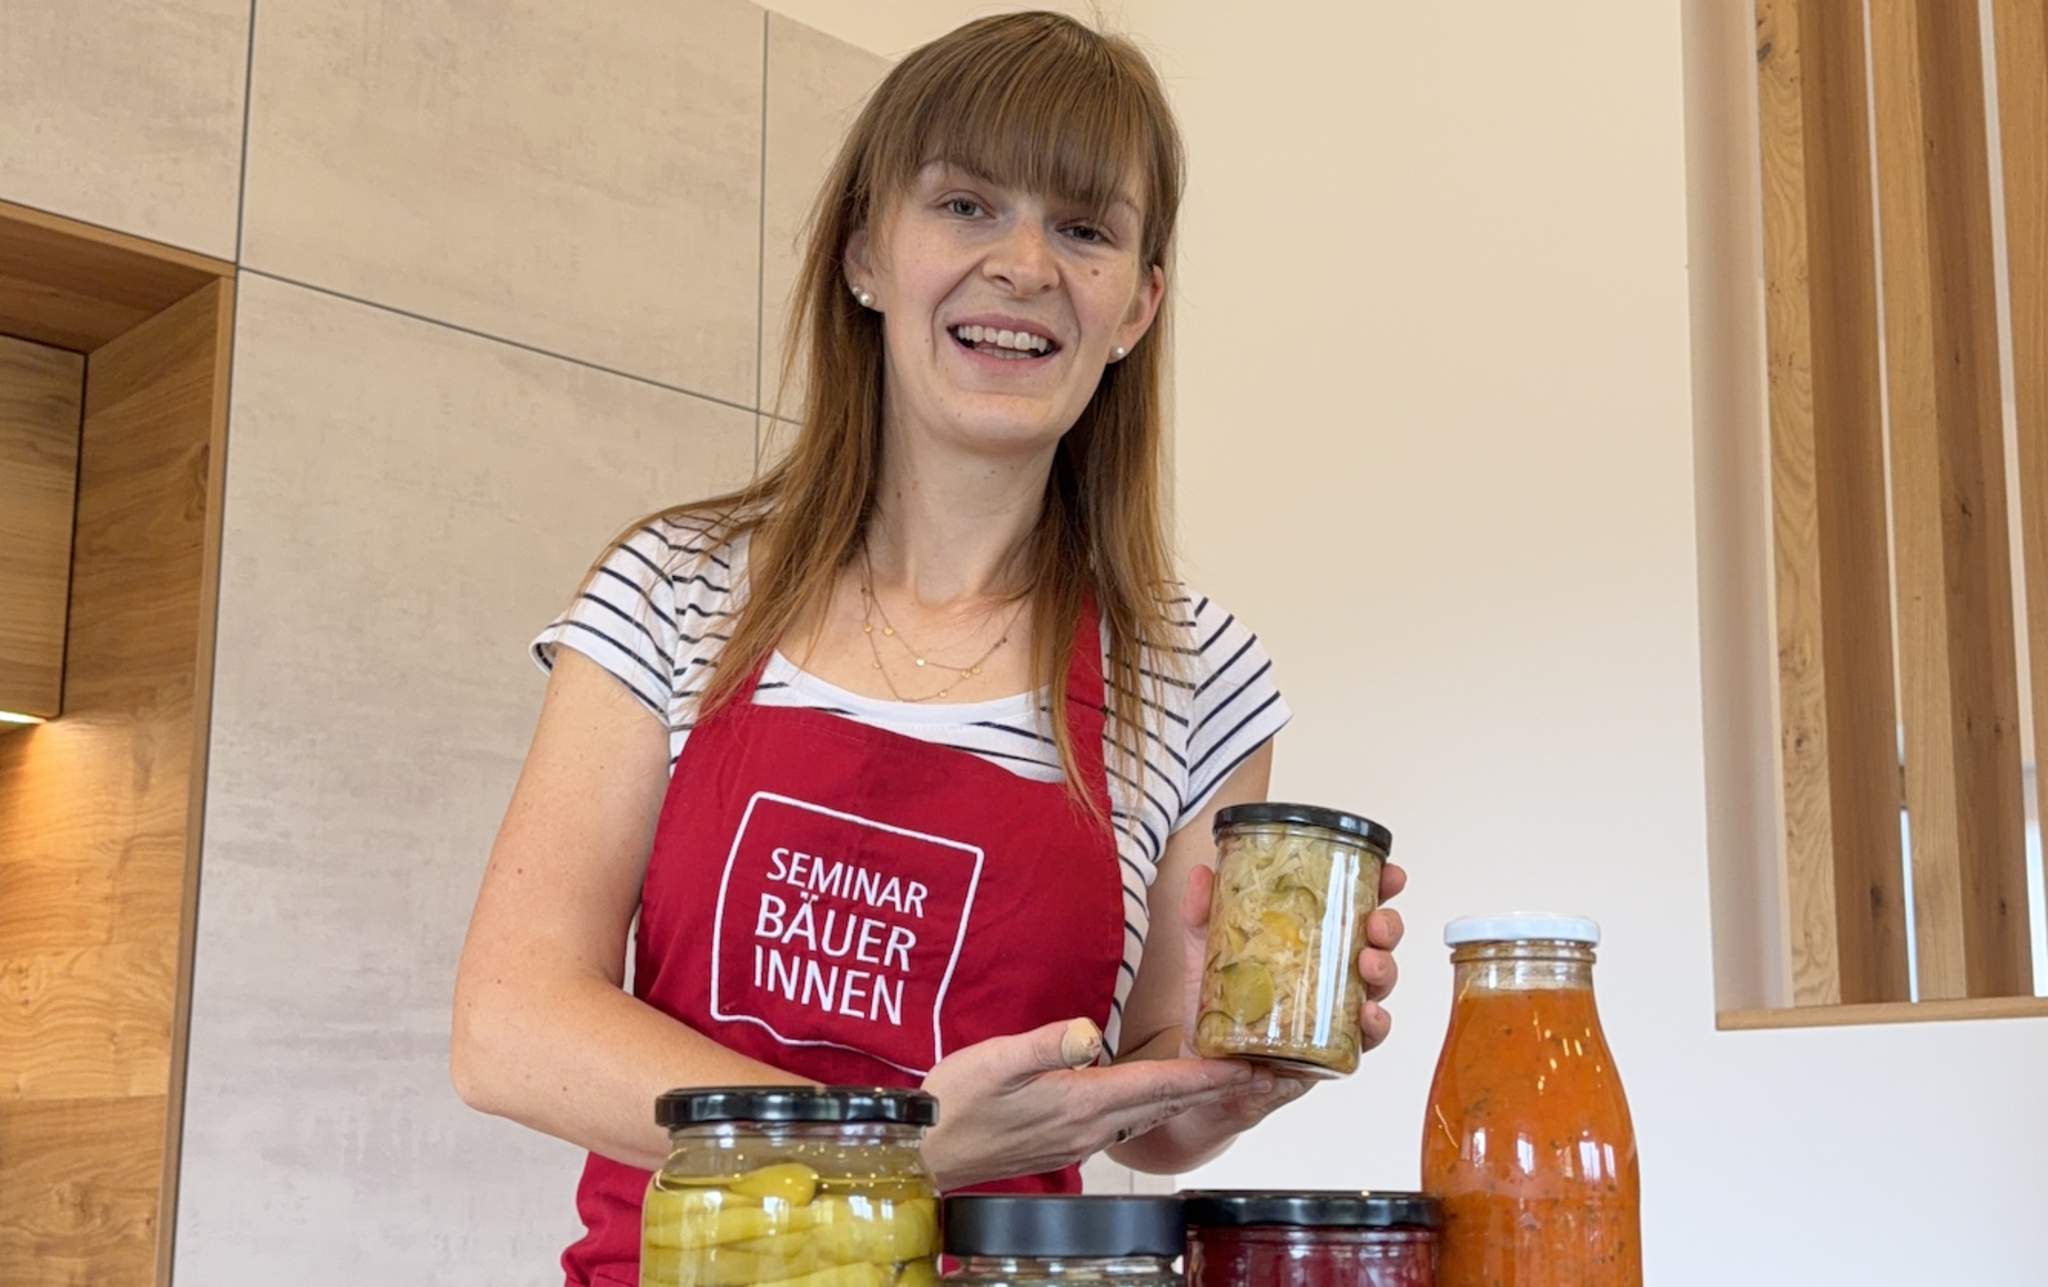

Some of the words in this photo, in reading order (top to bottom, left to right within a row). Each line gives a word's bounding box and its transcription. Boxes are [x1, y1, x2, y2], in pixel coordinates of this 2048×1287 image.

[766, 847, 928, 919] SEMINAR
[755, 891, 917, 972] BÄUER
[754, 945, 904, 1026] INNEN
